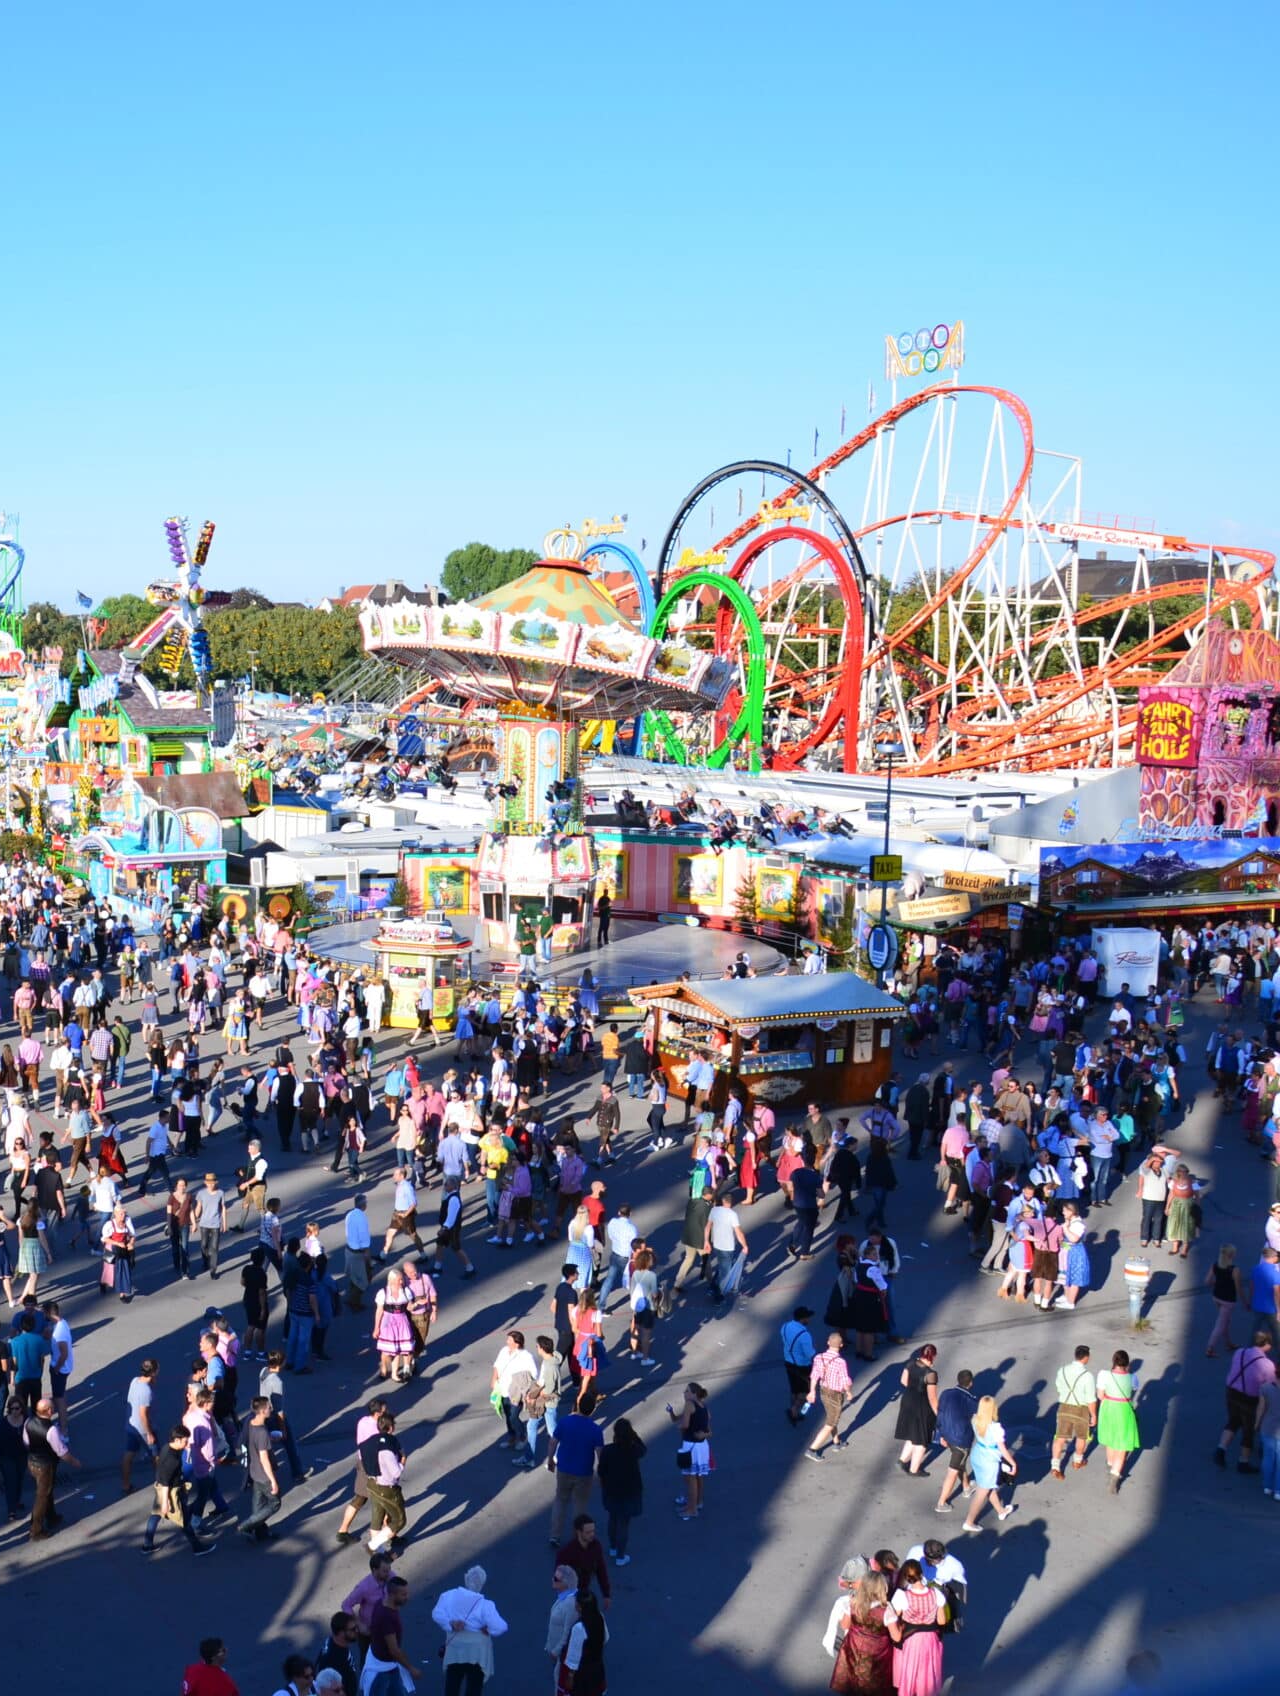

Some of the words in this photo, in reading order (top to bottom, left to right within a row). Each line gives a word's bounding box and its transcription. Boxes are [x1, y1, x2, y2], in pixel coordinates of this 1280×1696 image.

[1142, 701, 1194, 731] FAHRT
[1149, 720, 1180, 738] ZUR
[876, 862, 893, 874] TAXI
